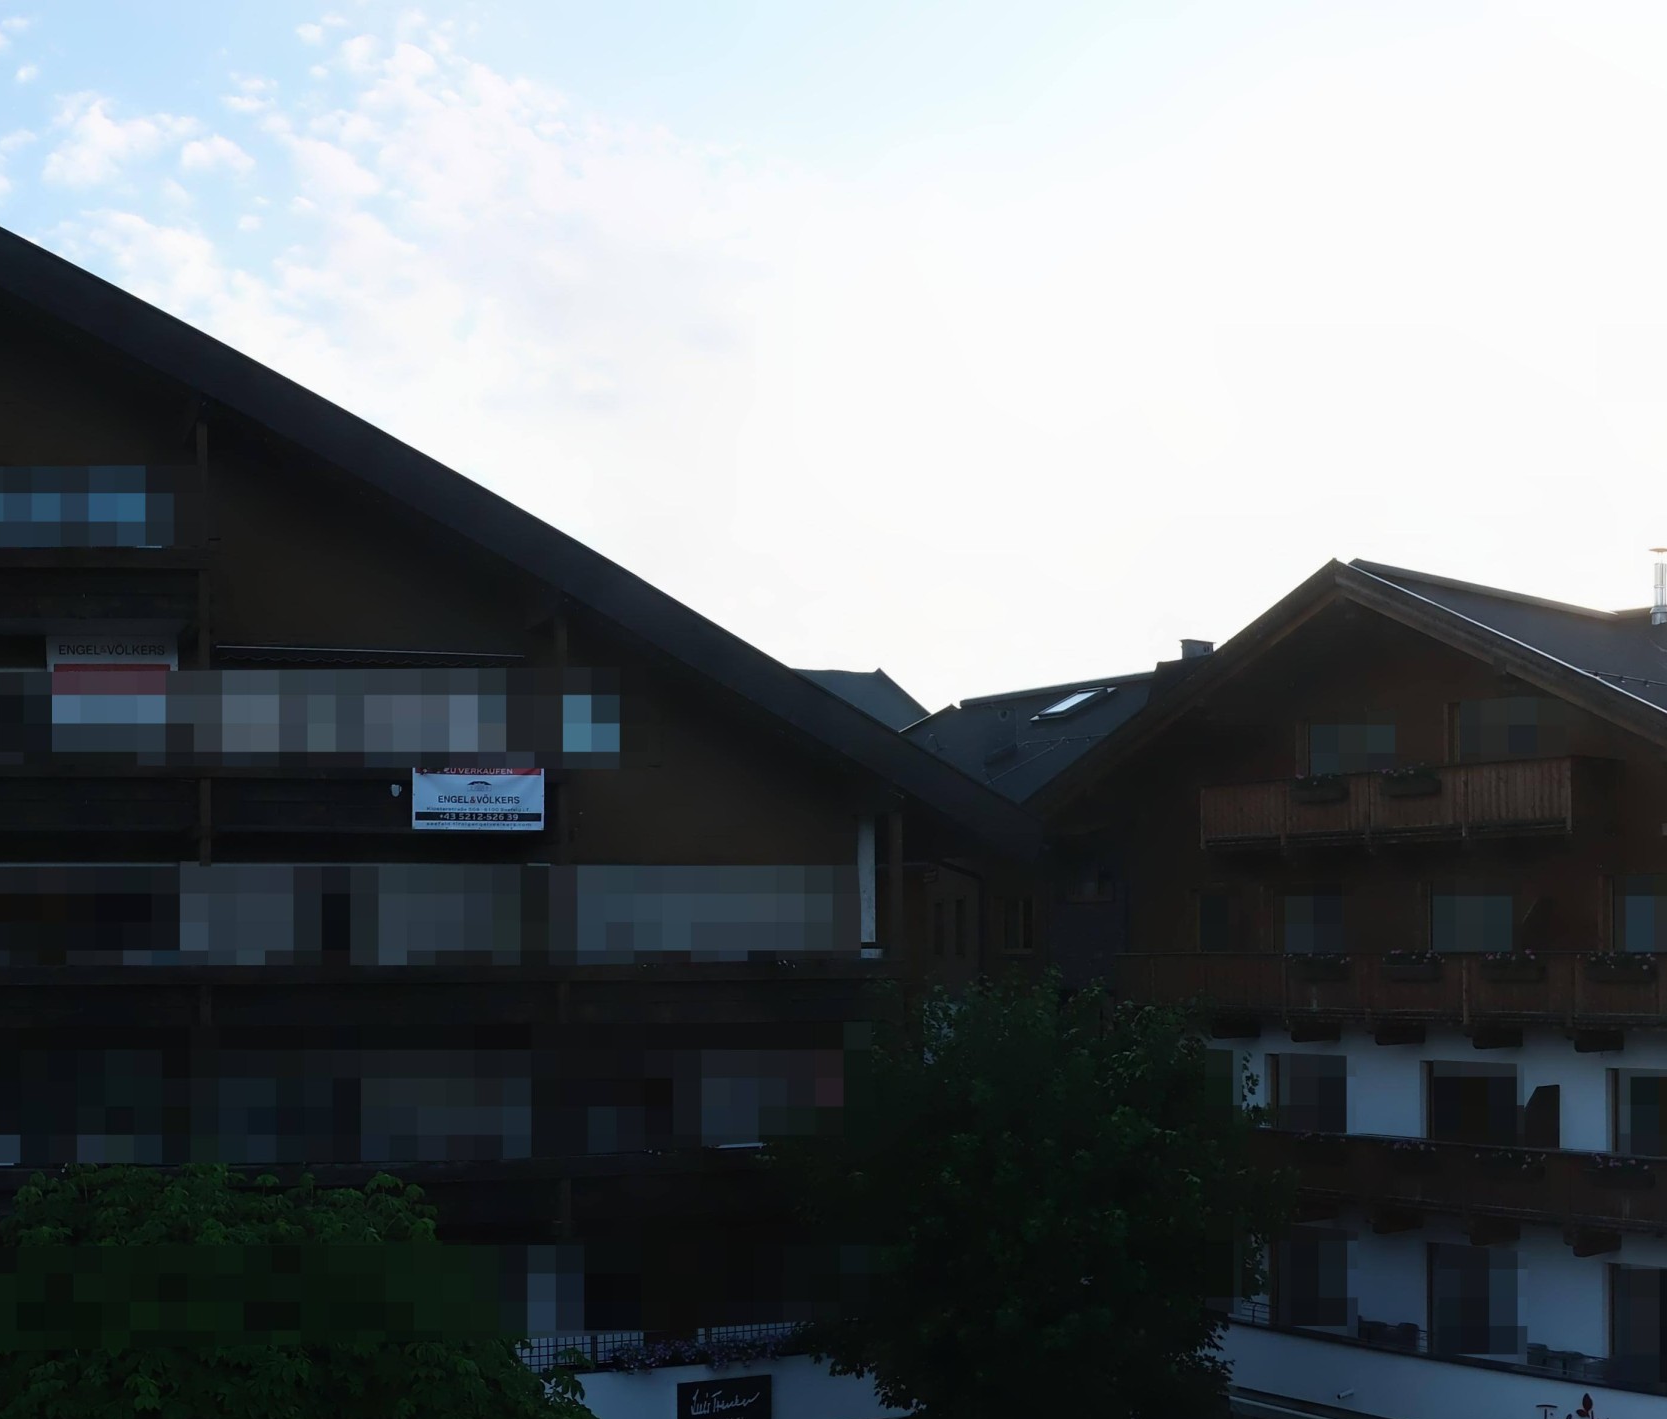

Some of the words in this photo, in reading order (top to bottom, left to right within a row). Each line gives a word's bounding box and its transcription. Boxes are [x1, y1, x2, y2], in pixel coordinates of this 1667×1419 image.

[437, 794, 520, 804] ENGEL&VÖLKERS
[458, 813, 506, 821] 5212-526
[508, 813, 519, 821] 39
